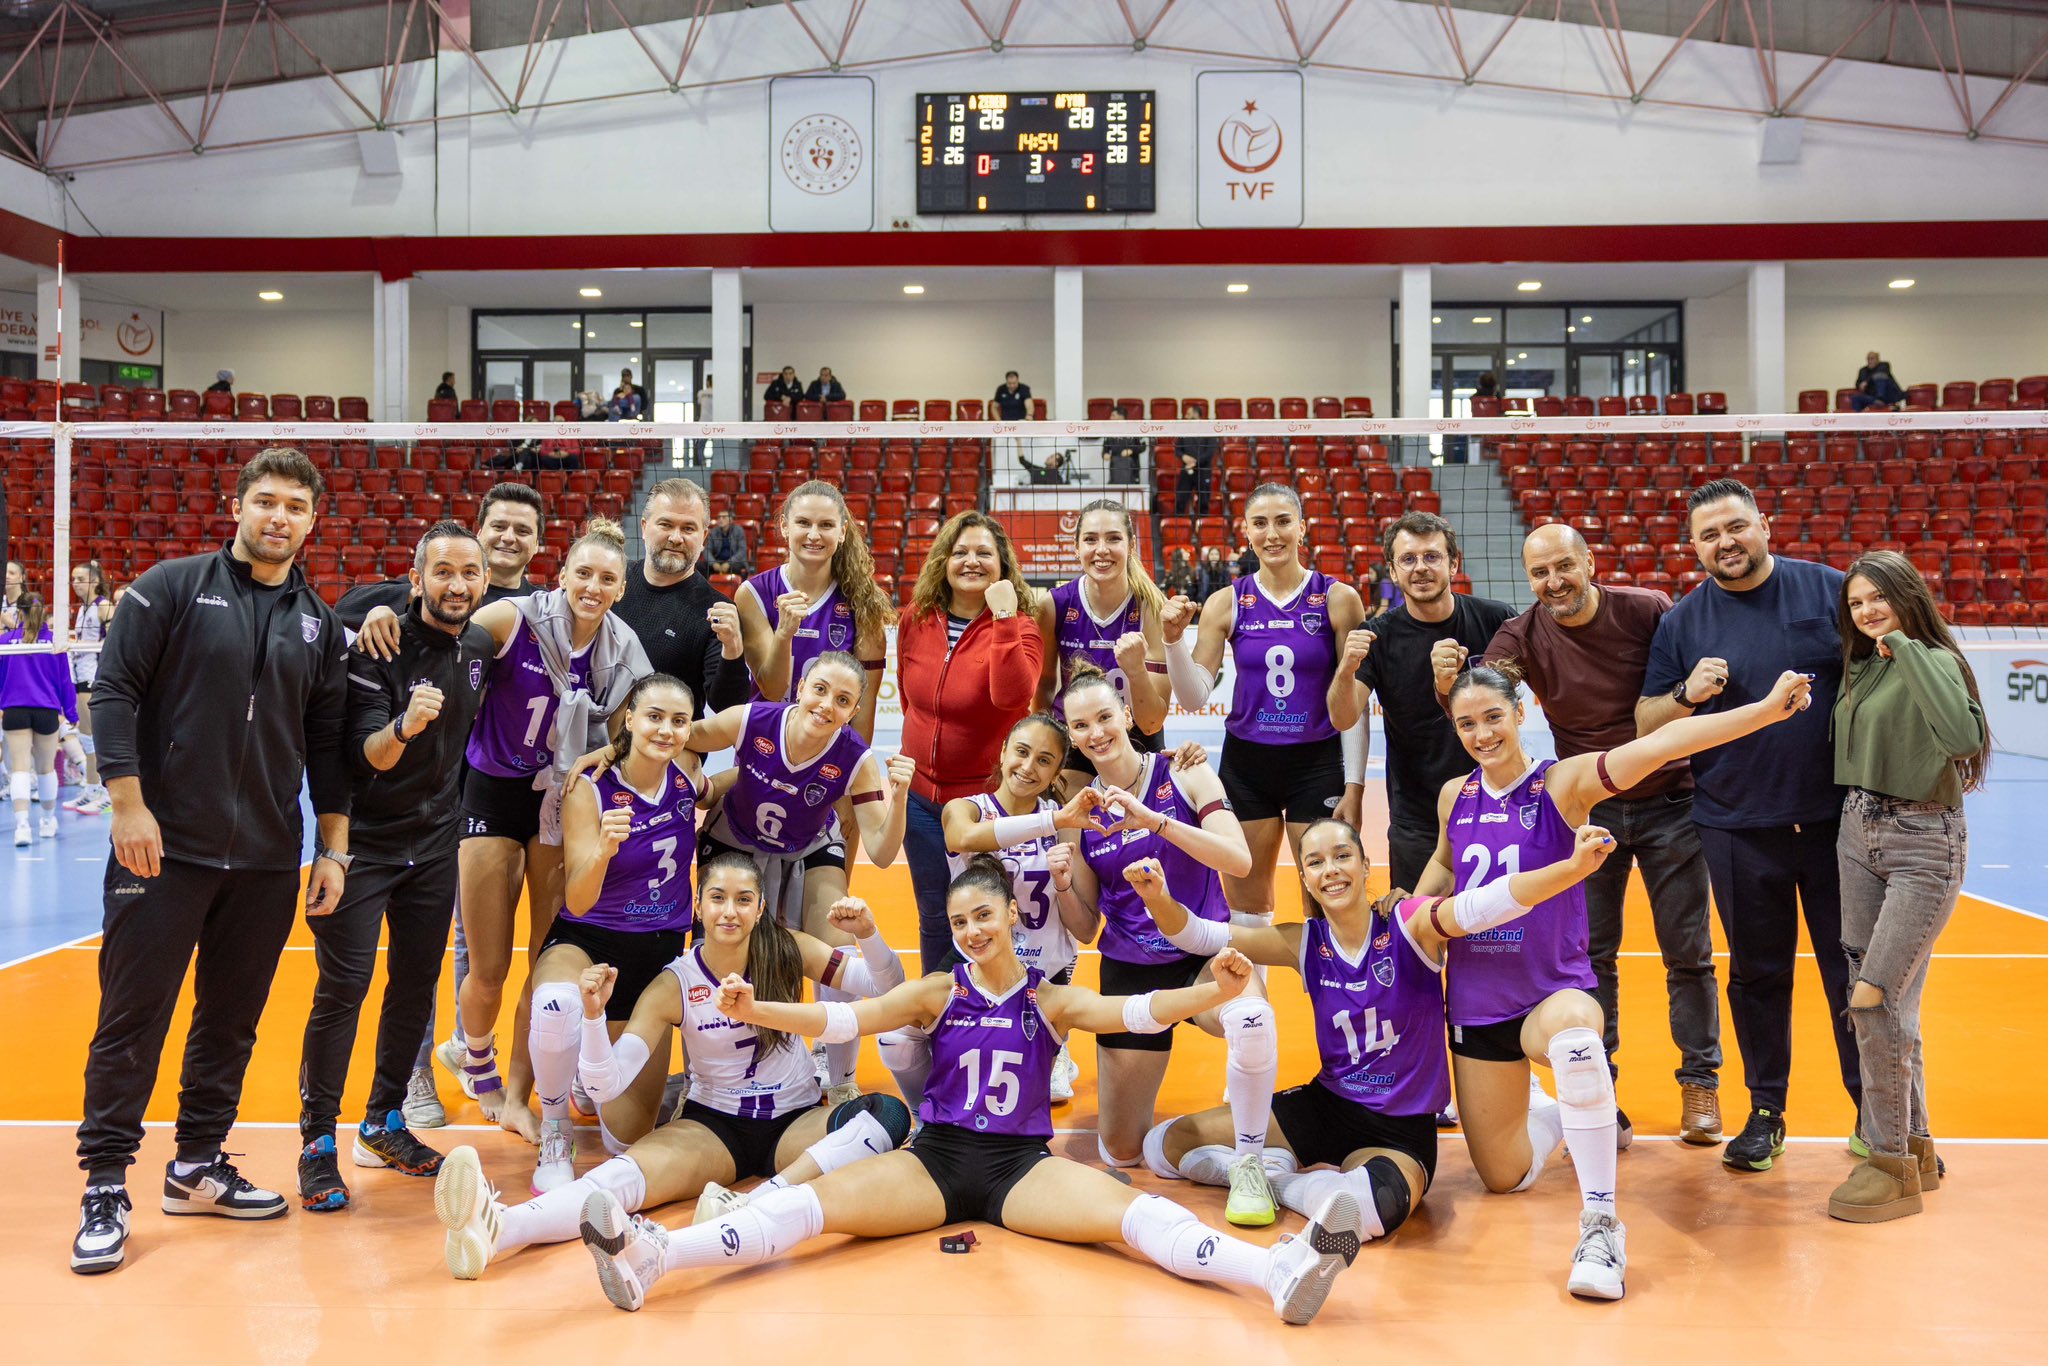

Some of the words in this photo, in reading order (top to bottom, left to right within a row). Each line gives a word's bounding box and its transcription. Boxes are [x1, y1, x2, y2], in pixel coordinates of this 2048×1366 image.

[926, 104, 932, 122] 1
[950, 104, 965, 122] 13
[979, 109, 1004, 130] 26
[1068, 107, 1094, 129] 28
[1106, 102, 1128, 121] 25
[1144, 102, 1151, 120] 1
[921, 125, 932, 144] 2
[950, 125, 965, 144] 19
[1018, 132, 1058, 152] 14:54
[1106, 124, 1128, 142] 25
[1138, 124, 1151, 142] 2
[922, 146, 932, 165] 3
[944, 146, 965, 165] 26
[1081, 153, 1094, 174] 2
[1106, 145, 1128, 164] 28
[1140, 144, 1151, 164] 3
[978, 154, 990, 175] 0
[1030, 154, 1042, 174] 3
[1226, 182, 1274, 200] TVF
[196, 592, 228, 608] diadora
[1264, 644, 1296, 698] 8
[1256, 708, 1308, 724] Özerband
[756, 802, 786, 848] 6
[648, 836, 678, 890] 3
[1461, 843, 1520, 892] 21
[115, 883, 146, 894] diadora
[624, 900, 677, 915] Özerband
[1010, 871, 1050, 930] 3
[688, 988, 708, 1000] Metin
[698, 1018, 728, 1032] diadora
[946, 1015, 976, 1027] diadora
[1332, 1006, 1400, 1064] 14
[734, 1036, 758, 1080] 7
[959, 1048, 1024, 1117] 15
